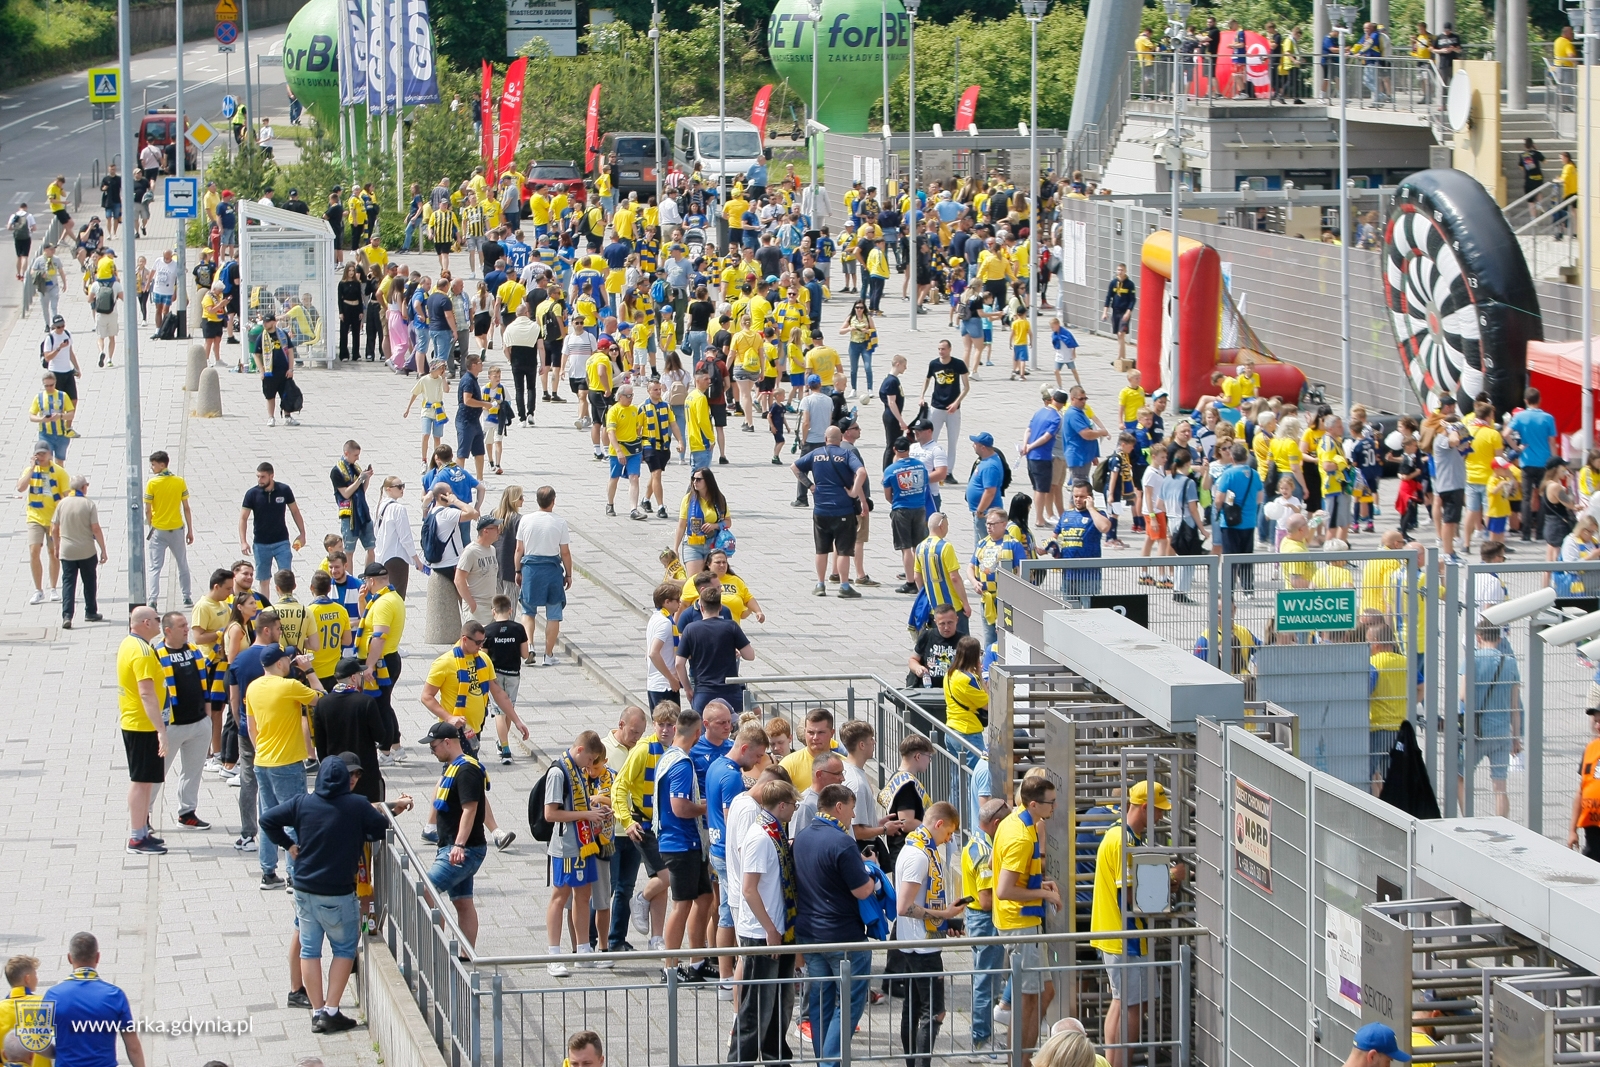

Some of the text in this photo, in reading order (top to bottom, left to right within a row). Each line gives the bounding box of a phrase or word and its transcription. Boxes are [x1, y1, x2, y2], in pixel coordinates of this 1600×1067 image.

[282, 32, 339, 72] forB
[828, 54, 873, 62] ZAKŁADY
[513, 252, 526, 267] 21
[1467, 277, 1479, 289] 13
[1480, 316, 1487, 327] 6
[723, 584, 737, 594] KS
[1282, 595, 1349, 612] WYJŚCIE
[319, 611, 340, 622] KREFT
[1279, 613, 1353, 624] EWAKUACYJNE
[320, 622, 341, 650] 18
[1244, 815, 1269, 848] NORD
[1244, 839, 1269, 861] SECURITY
[1339, 943, 1357, 968] Stadion
[1363, 983, 1394, 1020] SEKTOR
